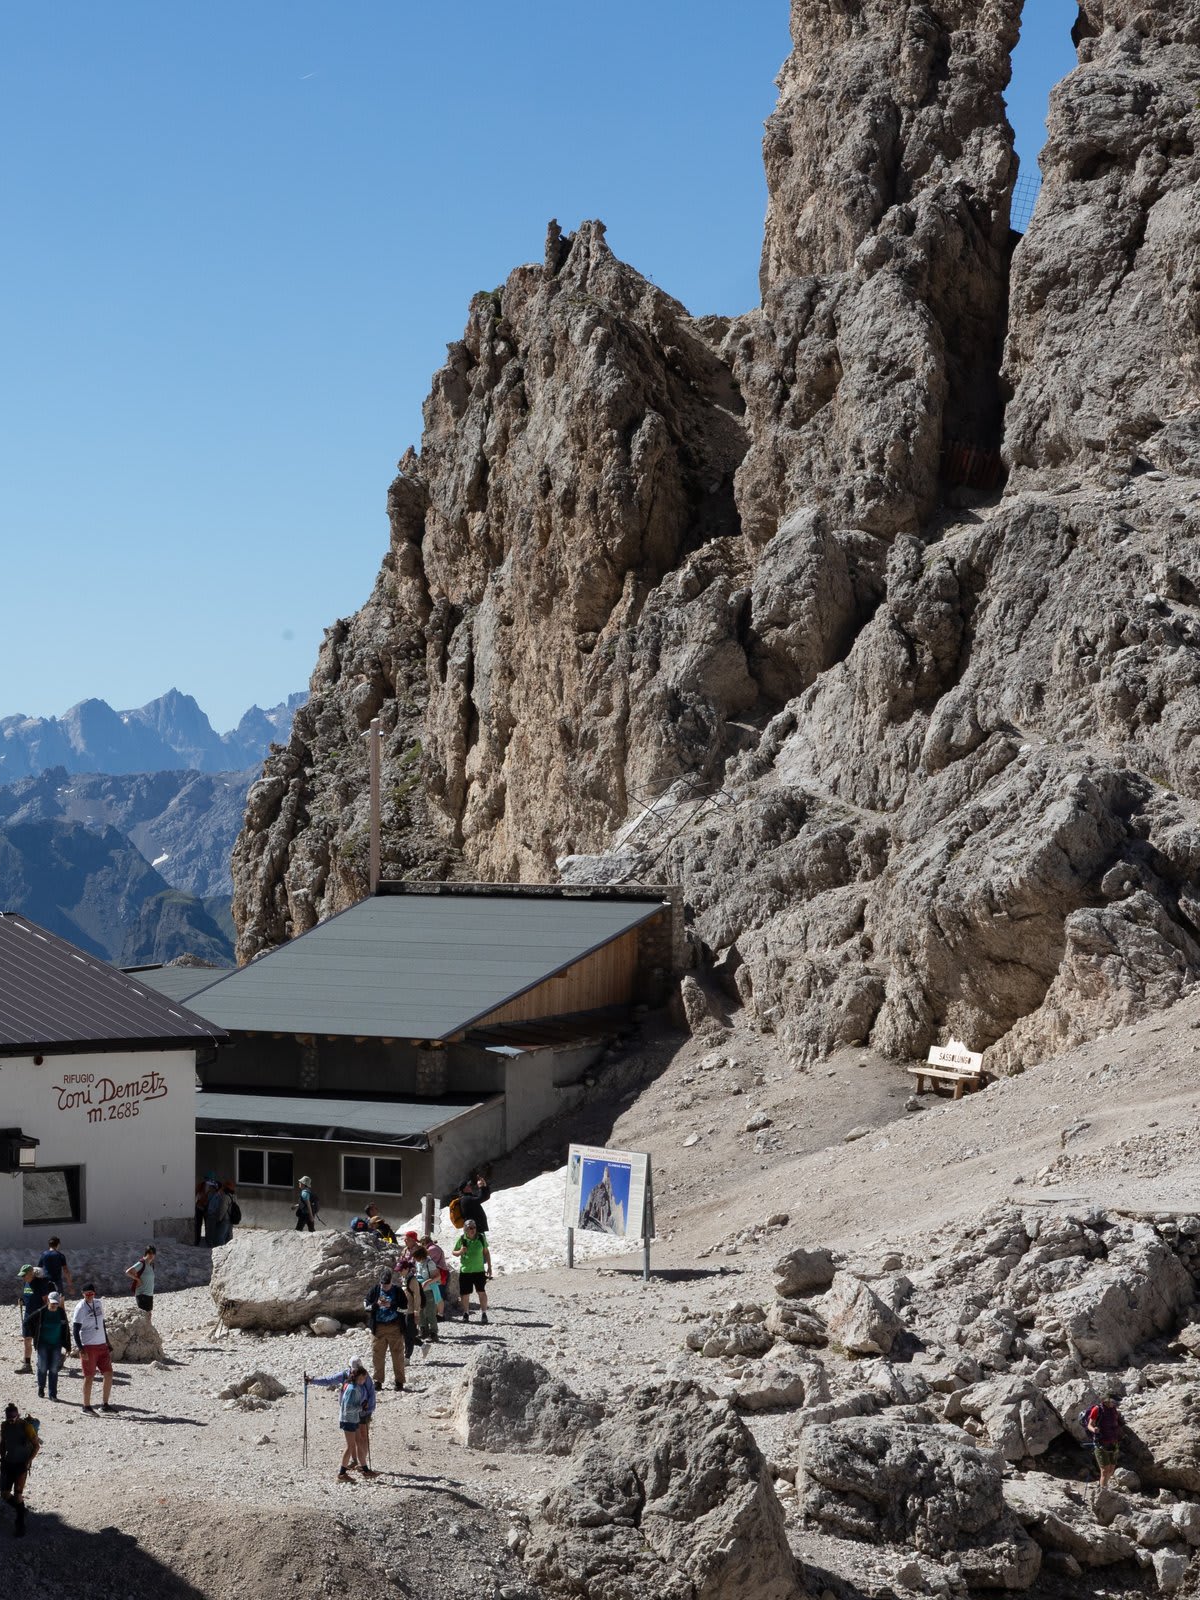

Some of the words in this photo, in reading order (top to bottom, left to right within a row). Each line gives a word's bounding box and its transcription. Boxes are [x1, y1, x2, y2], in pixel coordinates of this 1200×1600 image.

[939, 1053, 972, 1064] SASSOLUNGO
[63, 1073, 95, 1084] RIFUGIO
[52, 1084, 93, 1110] Toni
[95, 1071, 168, 1104] Demetz
